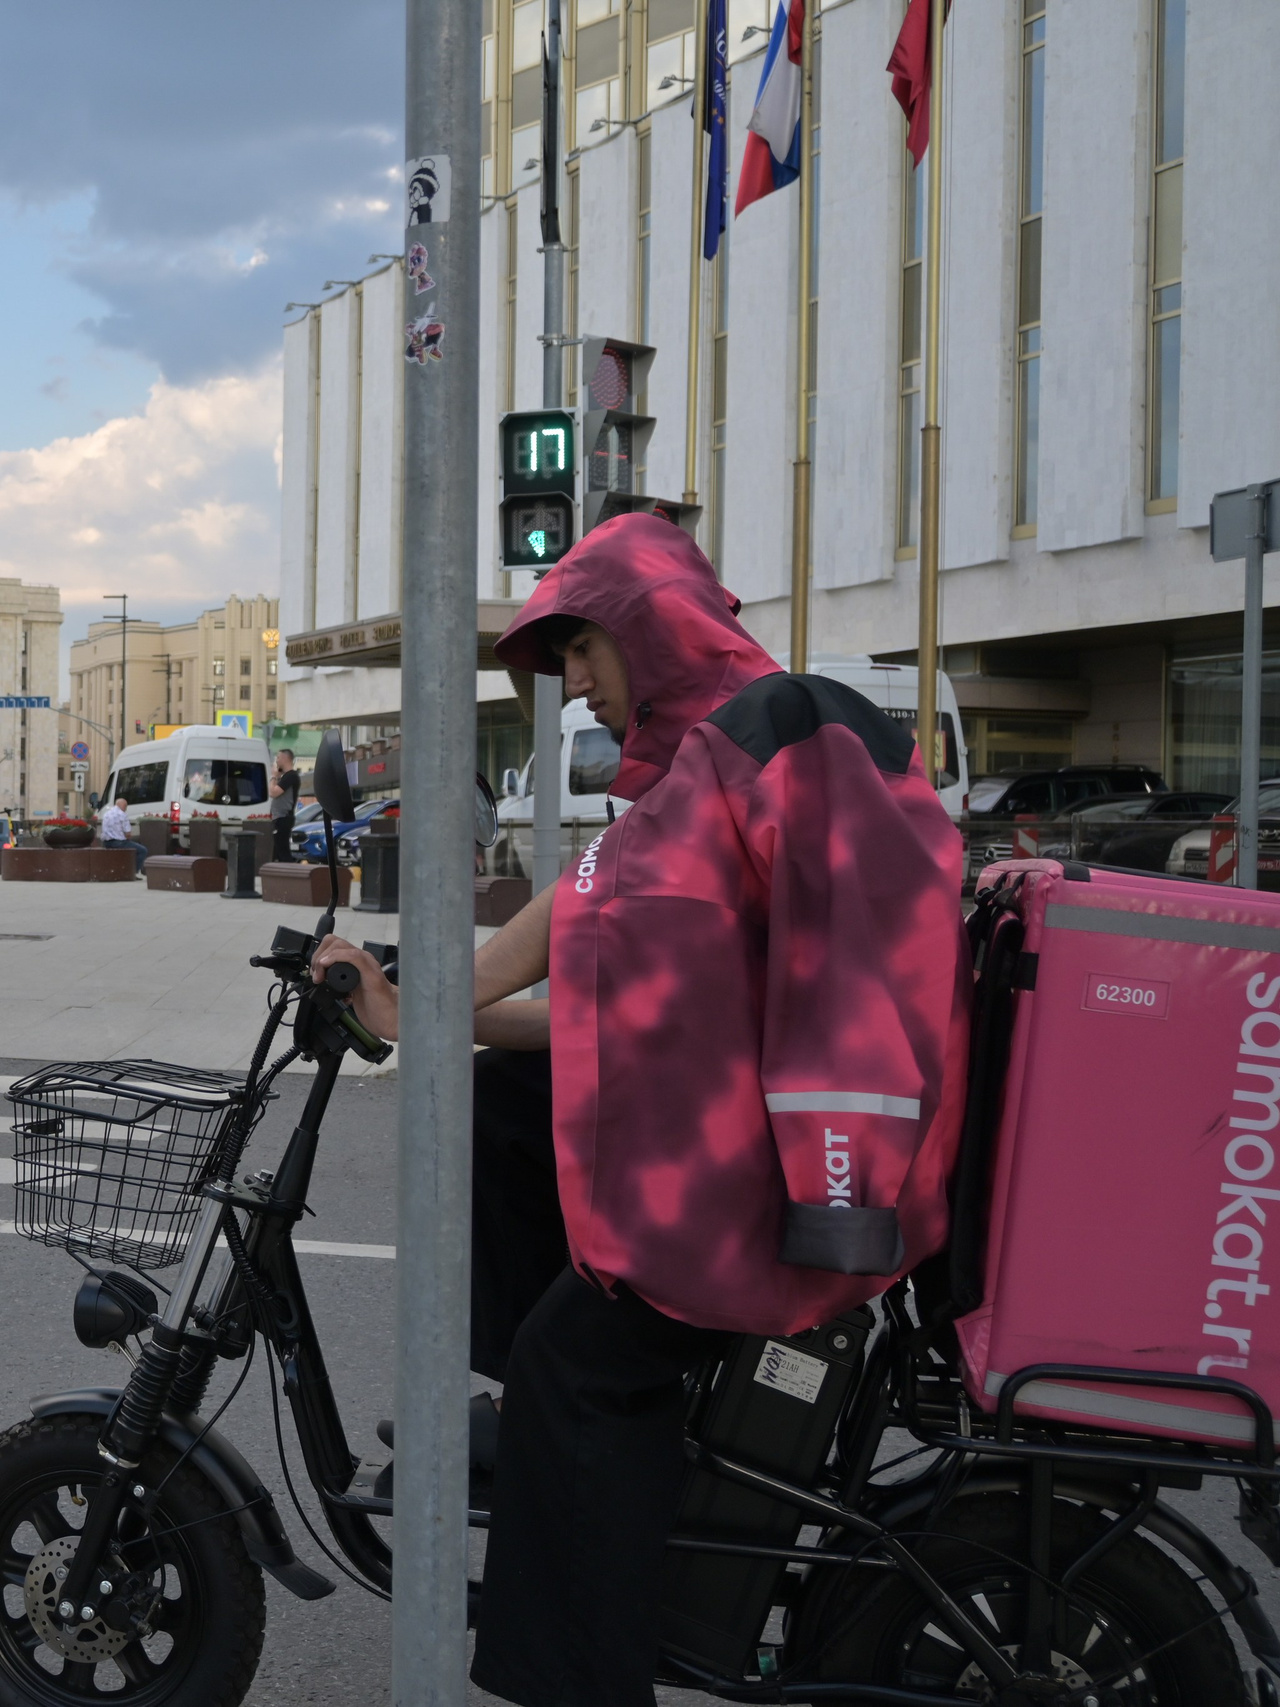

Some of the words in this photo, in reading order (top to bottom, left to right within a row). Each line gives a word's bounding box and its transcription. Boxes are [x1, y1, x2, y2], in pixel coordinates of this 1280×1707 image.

[530, 428, 565, 472] 17
[575, 828, 608, 894] само
[1096, 984, 1156, 1007] 62300
[800, 1358, 818, 1368] Battery
